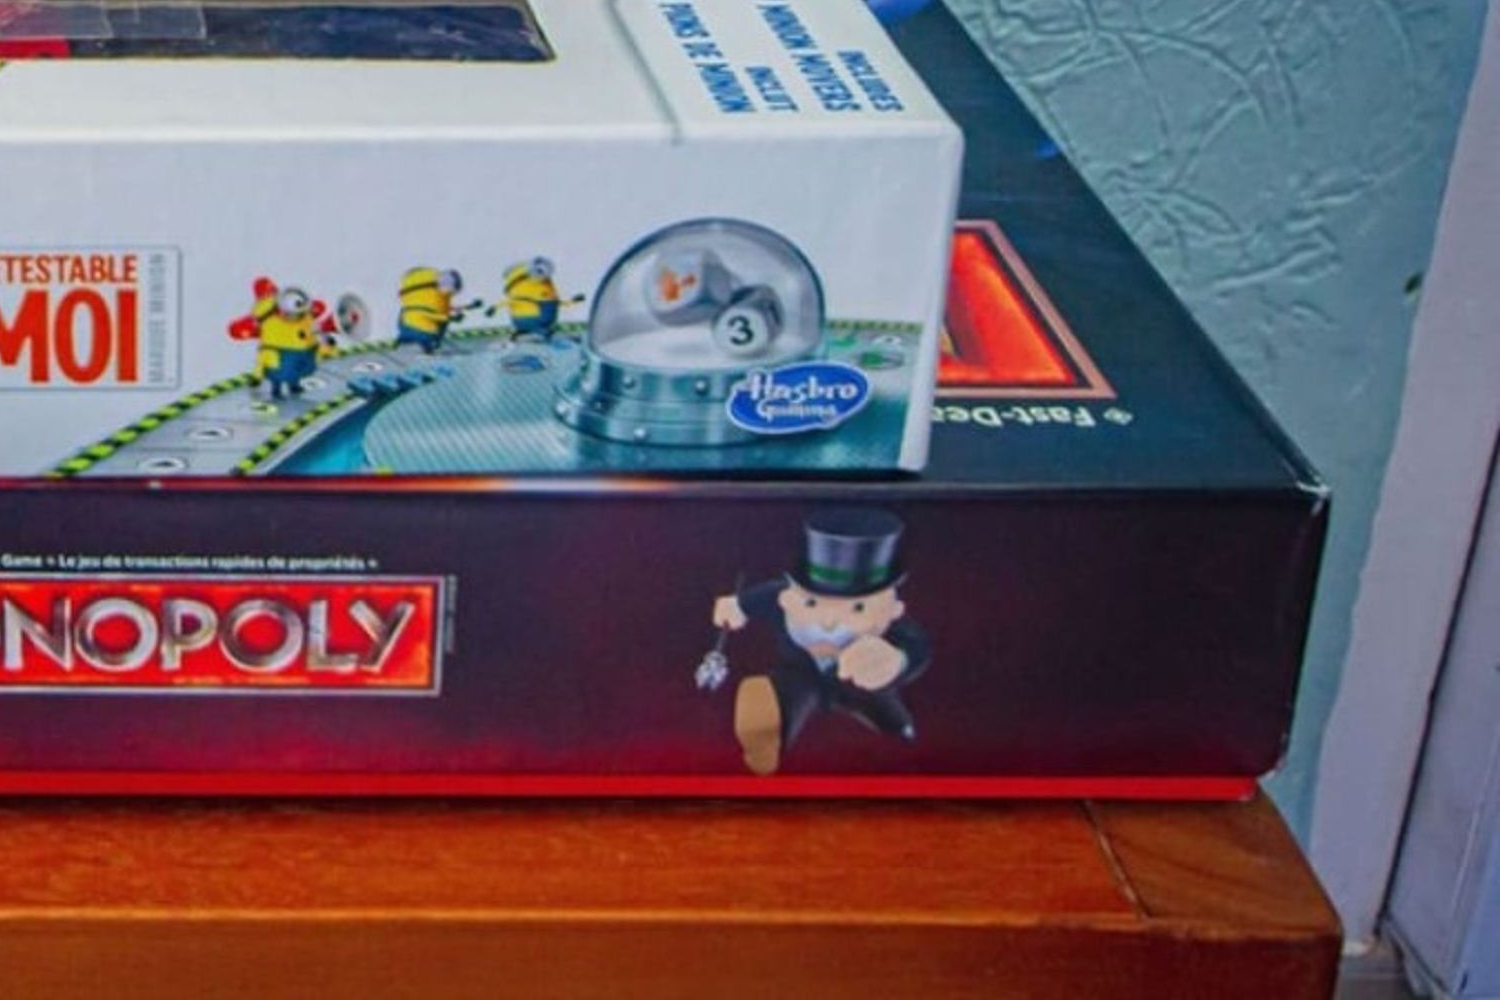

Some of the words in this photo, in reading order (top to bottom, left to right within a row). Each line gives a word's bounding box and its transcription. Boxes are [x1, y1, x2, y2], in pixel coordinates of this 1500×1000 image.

[791, 54, 862, 111] MOVERS
[728, 315, 754, 346] 3
[751, 372, 859, 403] Hasbro
[2, 554, 42, 567] Game
